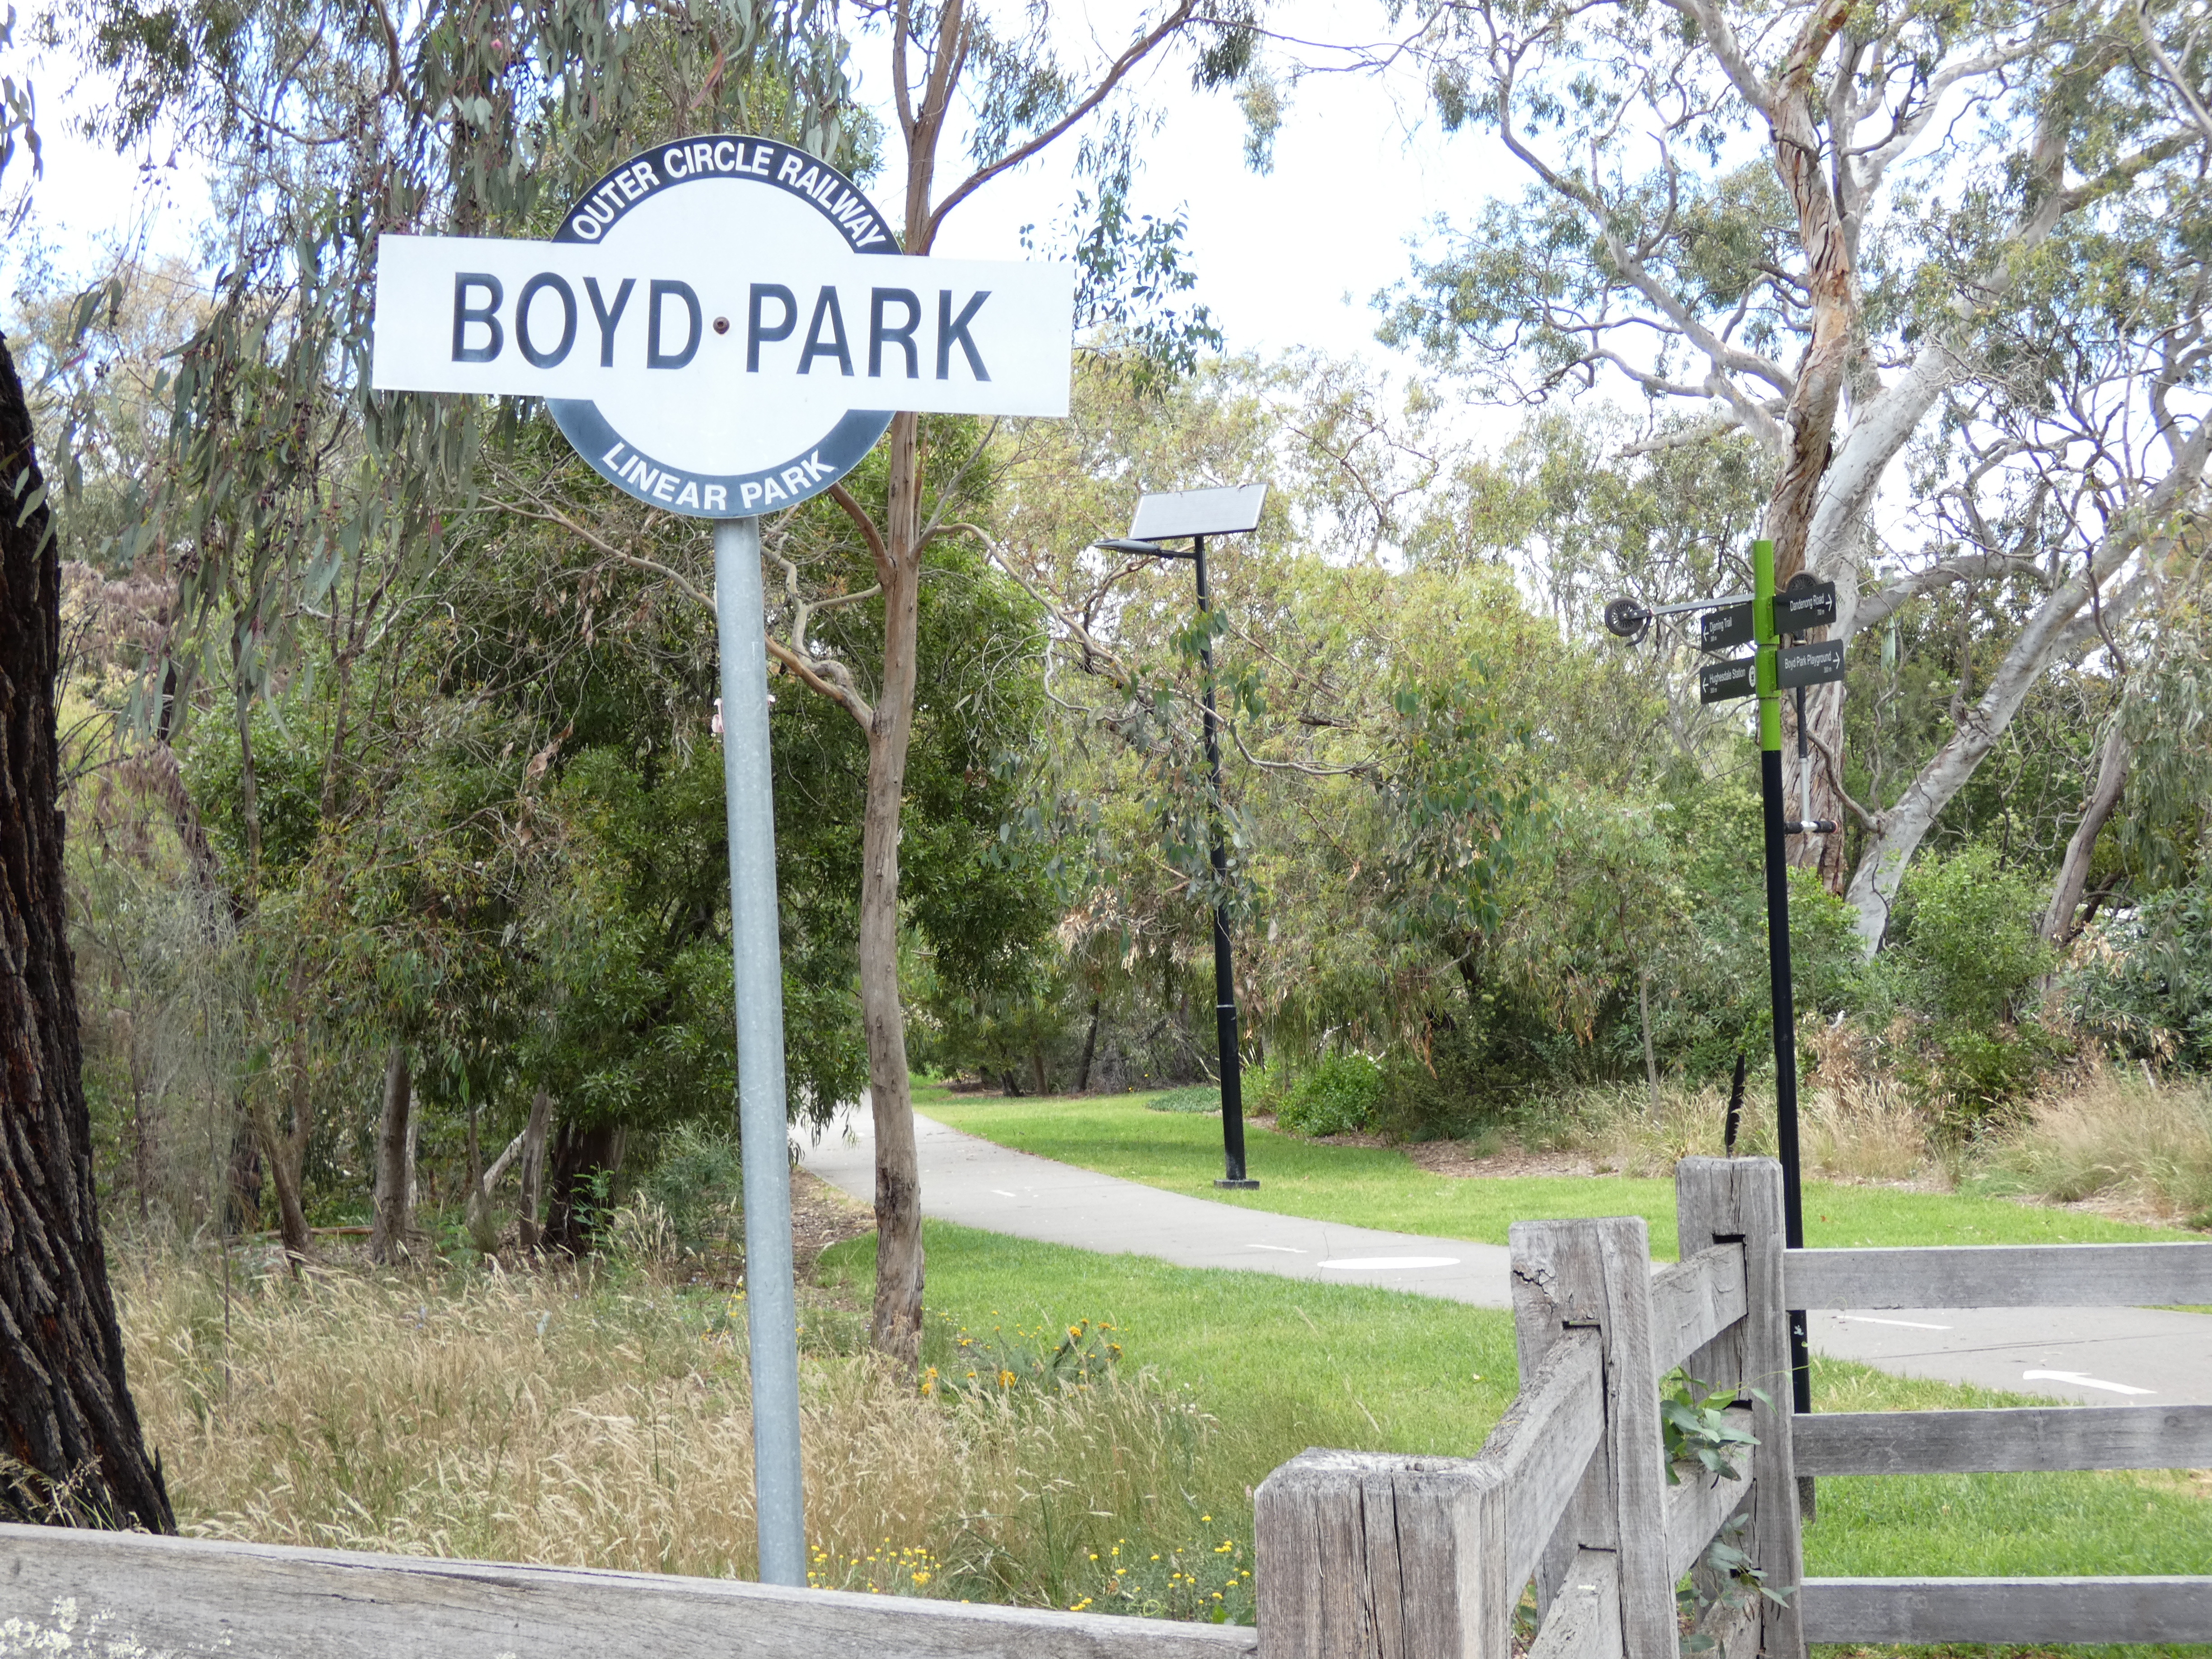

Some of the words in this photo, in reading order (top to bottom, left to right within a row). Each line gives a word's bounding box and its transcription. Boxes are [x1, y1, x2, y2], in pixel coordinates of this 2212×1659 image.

[572, 161, 660, 240] OUTER
[664, 141, 774, 179] CIRCLE
[777, 153, 886, 248] RAILWAY
[452, 272, 703, 370] BOYD
[746, 283, 992, 382] PARK
[602, 441, 727, 511] LINEAR
[740, 449, 835, 509] PARK
[1790, 598, 1813, 612] Dandenong
[1813, 592, 1824, 606] Road
[1724, 616, 1733, 628] Trail
[1785, 657, 1796, 671] Boyd
[1796, 656, 1807, 667] Park
[1807, 650, 1832, 667] Playground
[1709, 670, 1732, 686] Hughesdale
[1732, 668, 1746, 680] Station
